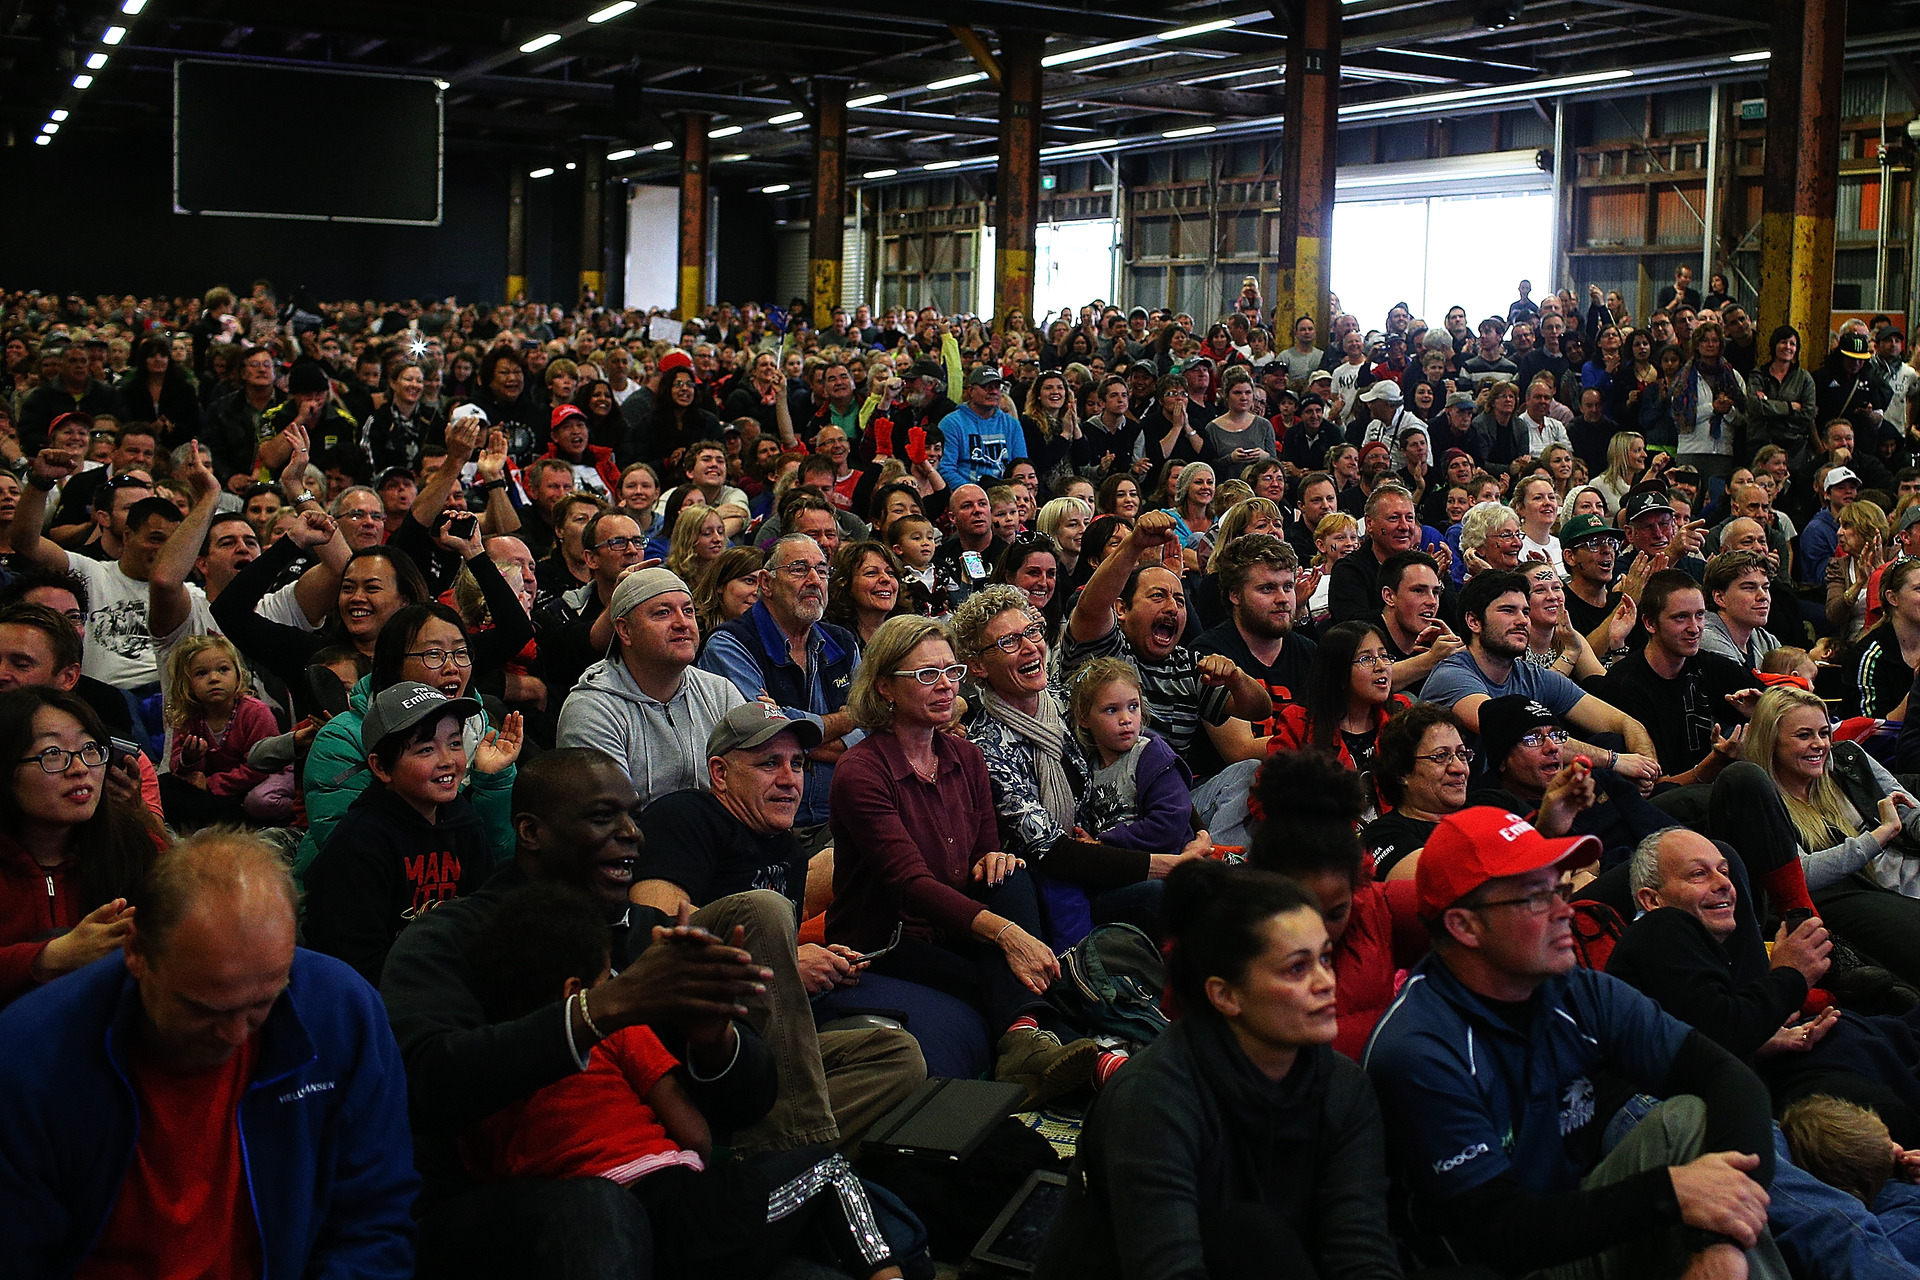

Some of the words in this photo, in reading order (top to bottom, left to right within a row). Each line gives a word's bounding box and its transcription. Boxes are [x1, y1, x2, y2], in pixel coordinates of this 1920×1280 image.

[1305, 56, 1321, 70] 11
[1373, 845, 1395, 867] EPHERD
[403, 851, 462, 886] MAN
[304, 1081, 336, 1093] ANSEN
